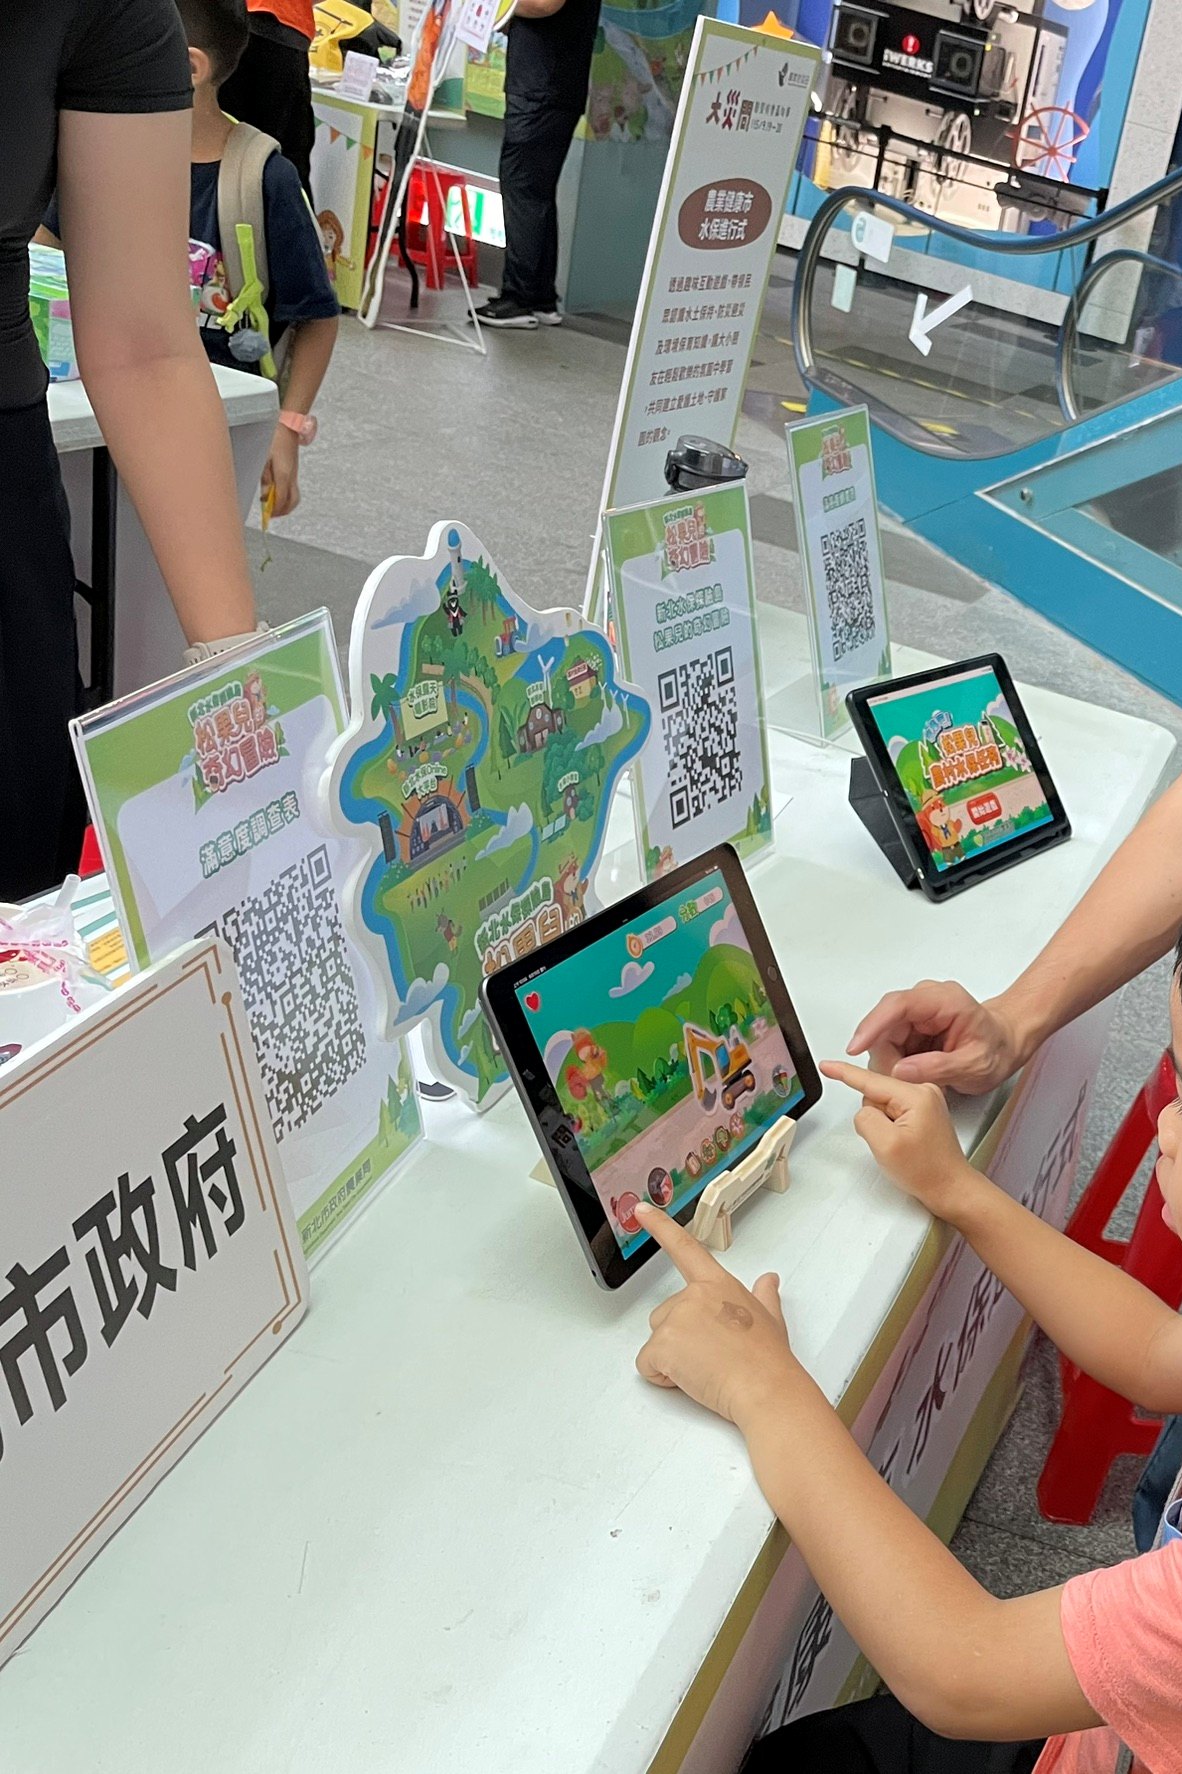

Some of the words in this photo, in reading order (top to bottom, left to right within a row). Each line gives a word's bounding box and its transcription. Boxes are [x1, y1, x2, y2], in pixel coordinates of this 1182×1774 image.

[698, 218, 748, 241] 水保進行式
[704, 189, 753, 214] 農業健康市
[199, 790, 300, 879] 滿意度調查表
[0, 1102, 246, 1428] 市政府
